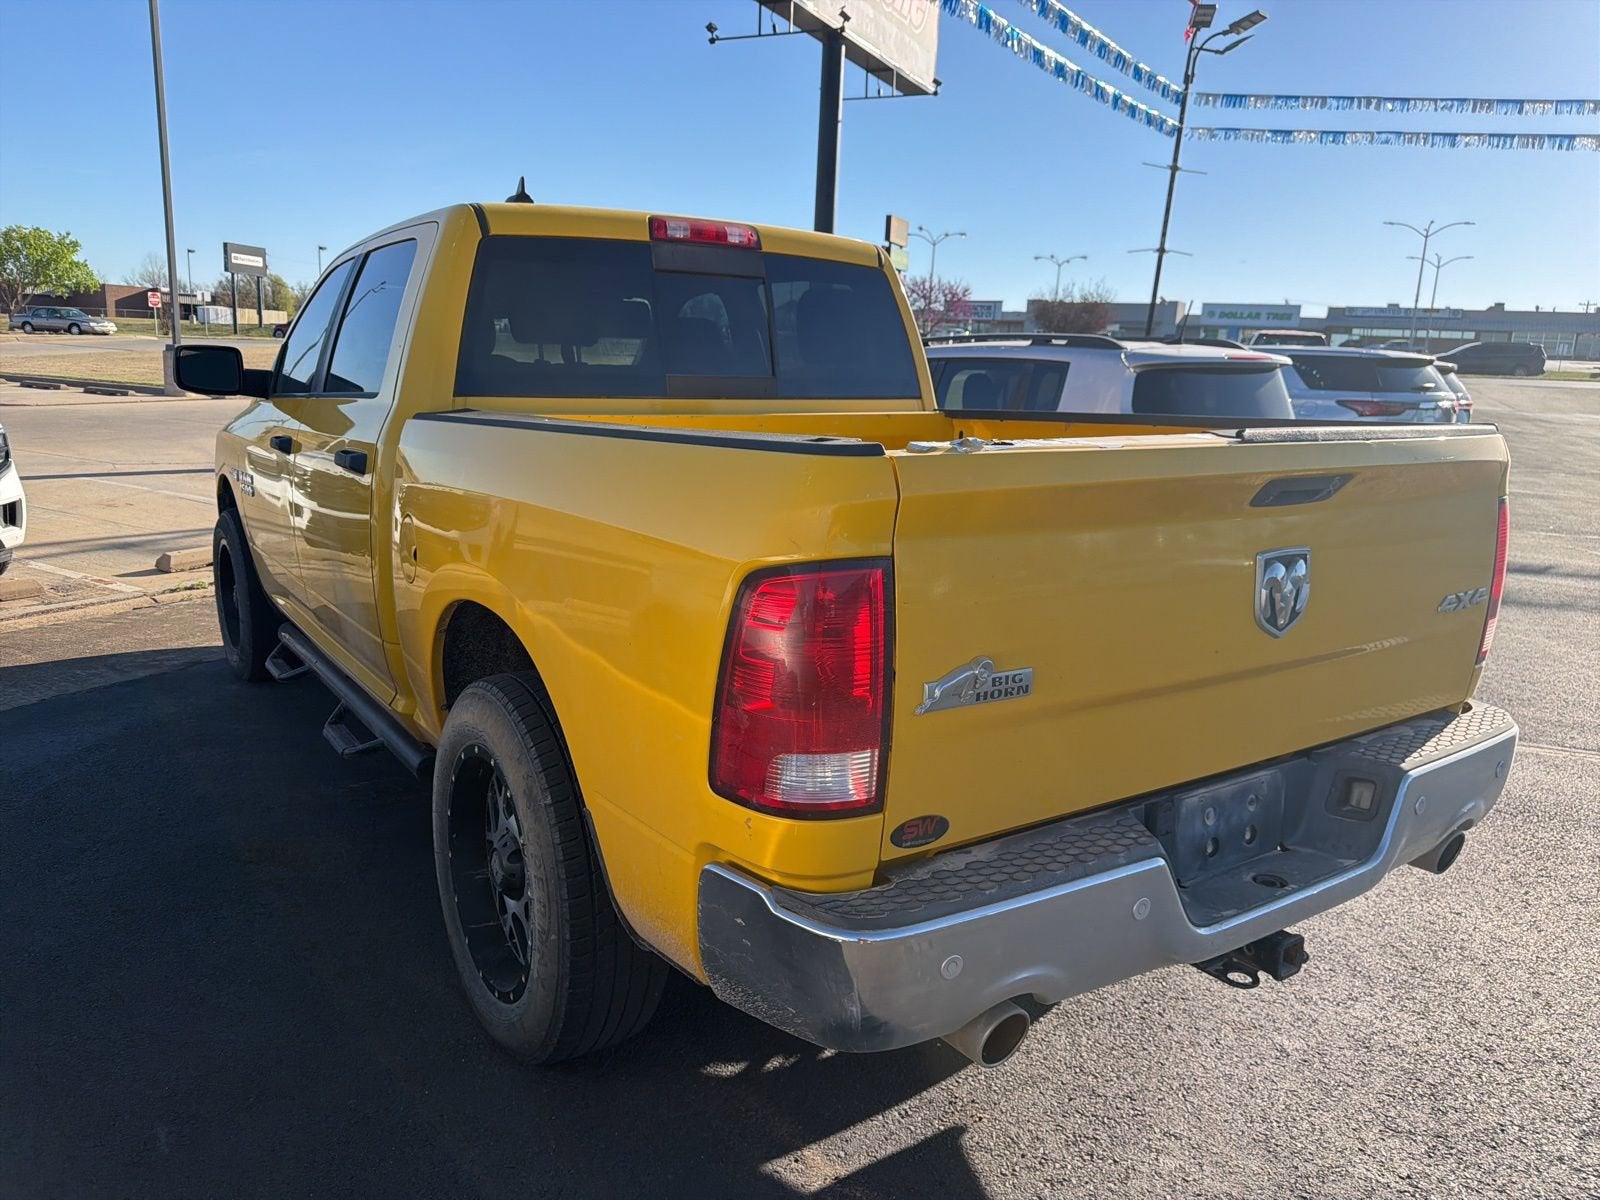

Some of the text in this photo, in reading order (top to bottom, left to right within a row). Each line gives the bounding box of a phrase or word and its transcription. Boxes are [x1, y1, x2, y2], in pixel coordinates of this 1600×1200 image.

[1218, 311, 1293, 320] DOLLAR TREE
[991, 673, 1024, 688] BIG
[975, 684, 1029, 702] HORN
[902, 816, 939, 840] SW
